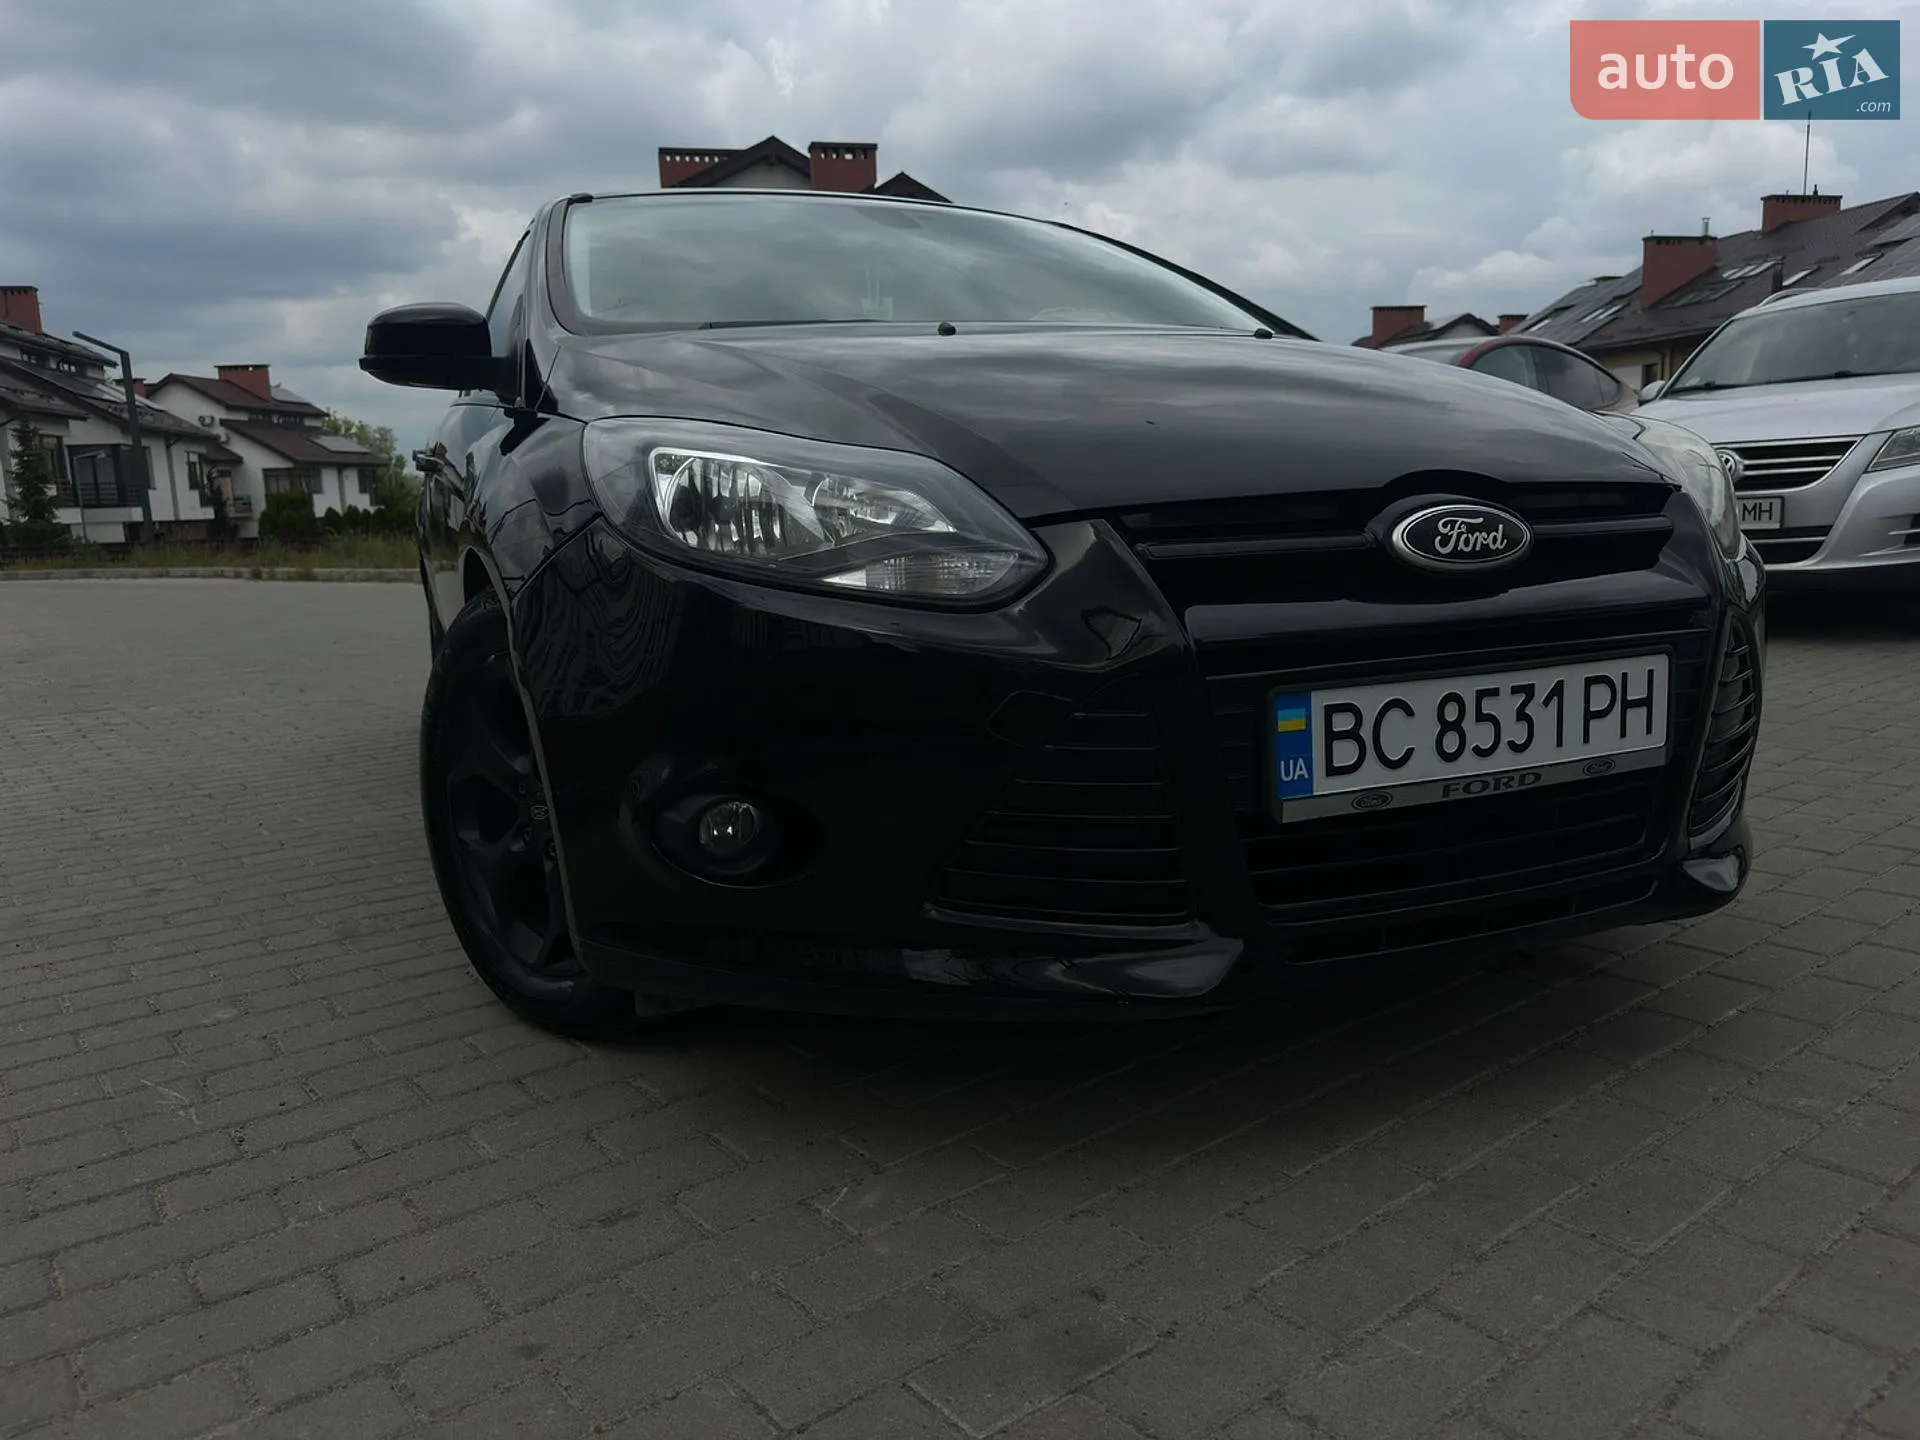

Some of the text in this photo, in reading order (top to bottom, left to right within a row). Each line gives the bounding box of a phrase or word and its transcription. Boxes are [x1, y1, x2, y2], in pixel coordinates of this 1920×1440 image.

[1742, 502, 1772, 521] MH
[1434, 517, 1507, 554] Ford
[1323, 668, 1654, 777] BC 8531 PH
[1281, 757, 1308, 782] UA
[1441, 771, 1542, 799] FORD
